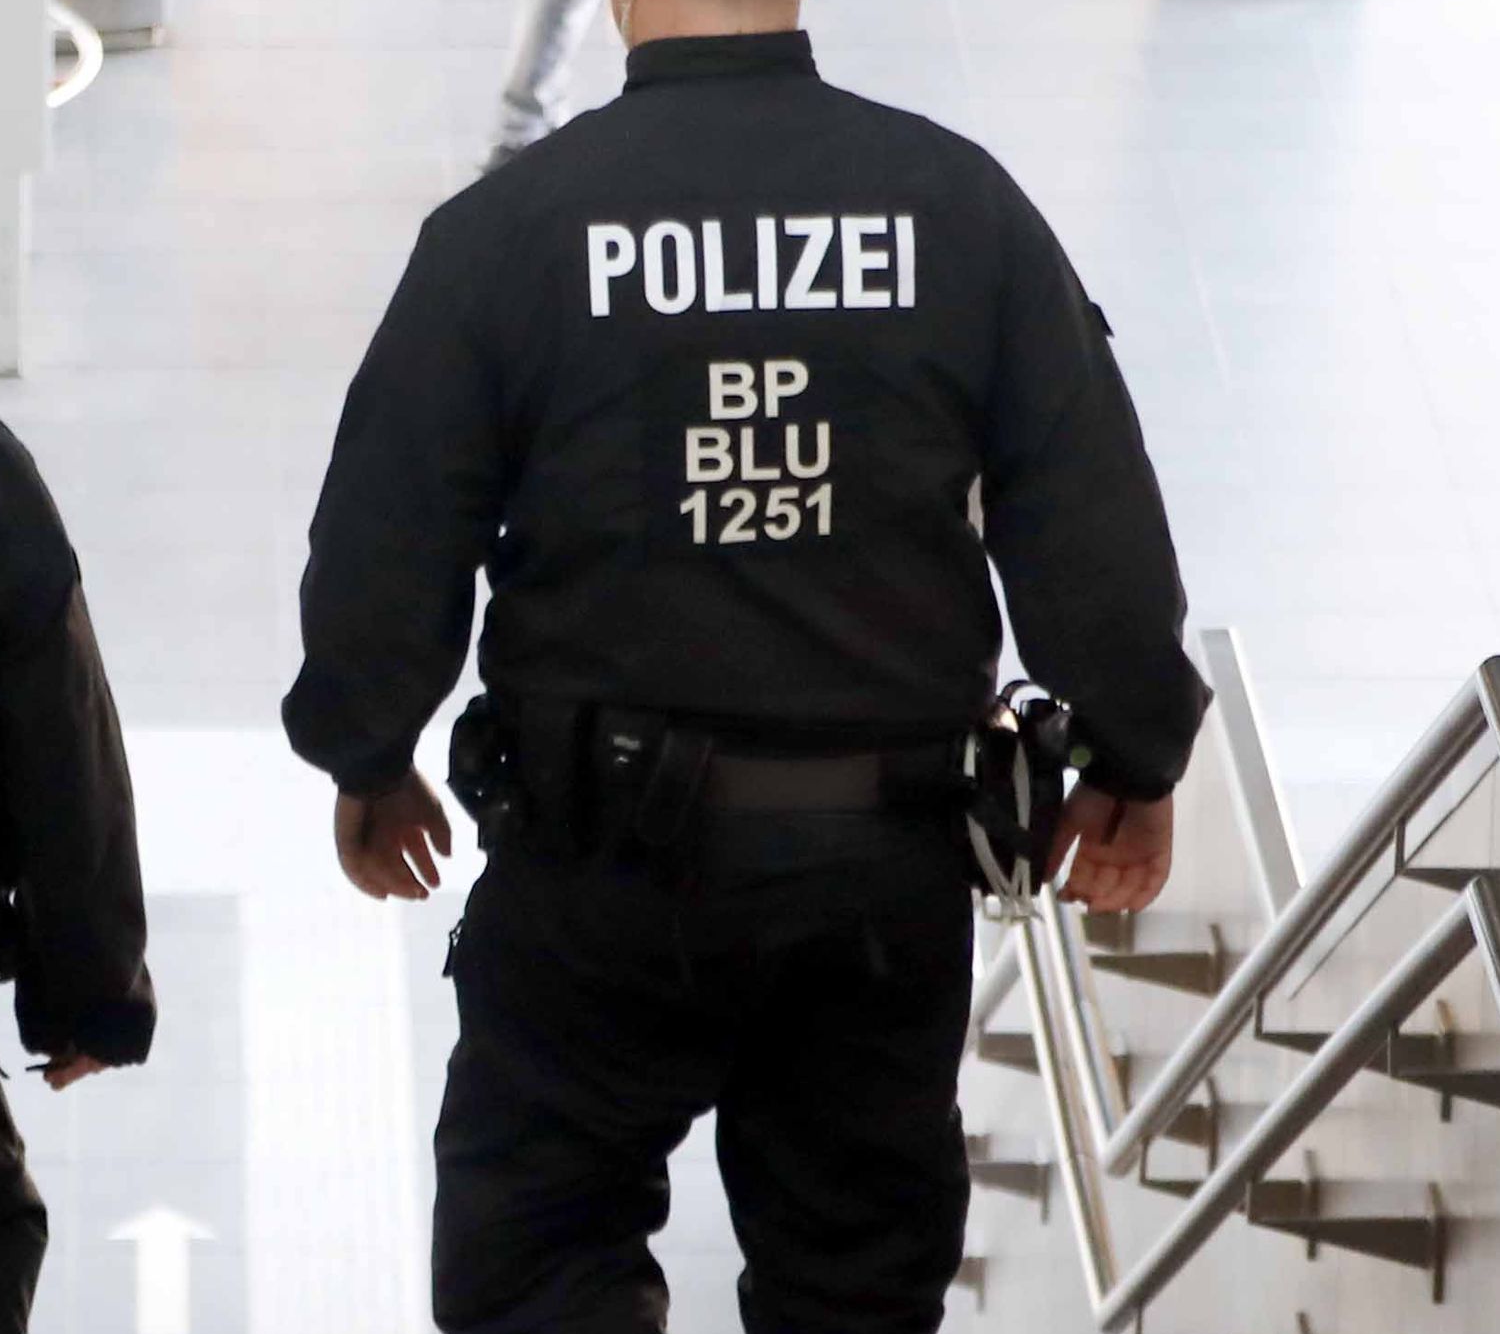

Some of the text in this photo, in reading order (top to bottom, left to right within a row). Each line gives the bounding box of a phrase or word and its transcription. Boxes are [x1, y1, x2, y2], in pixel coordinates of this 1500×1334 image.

[586, 215, 916, 318] POLIZEI
[707, 359, 810, 422] BP
[685, 420, 832, 483] BLU
[679, 482, 834, 545] 1251
